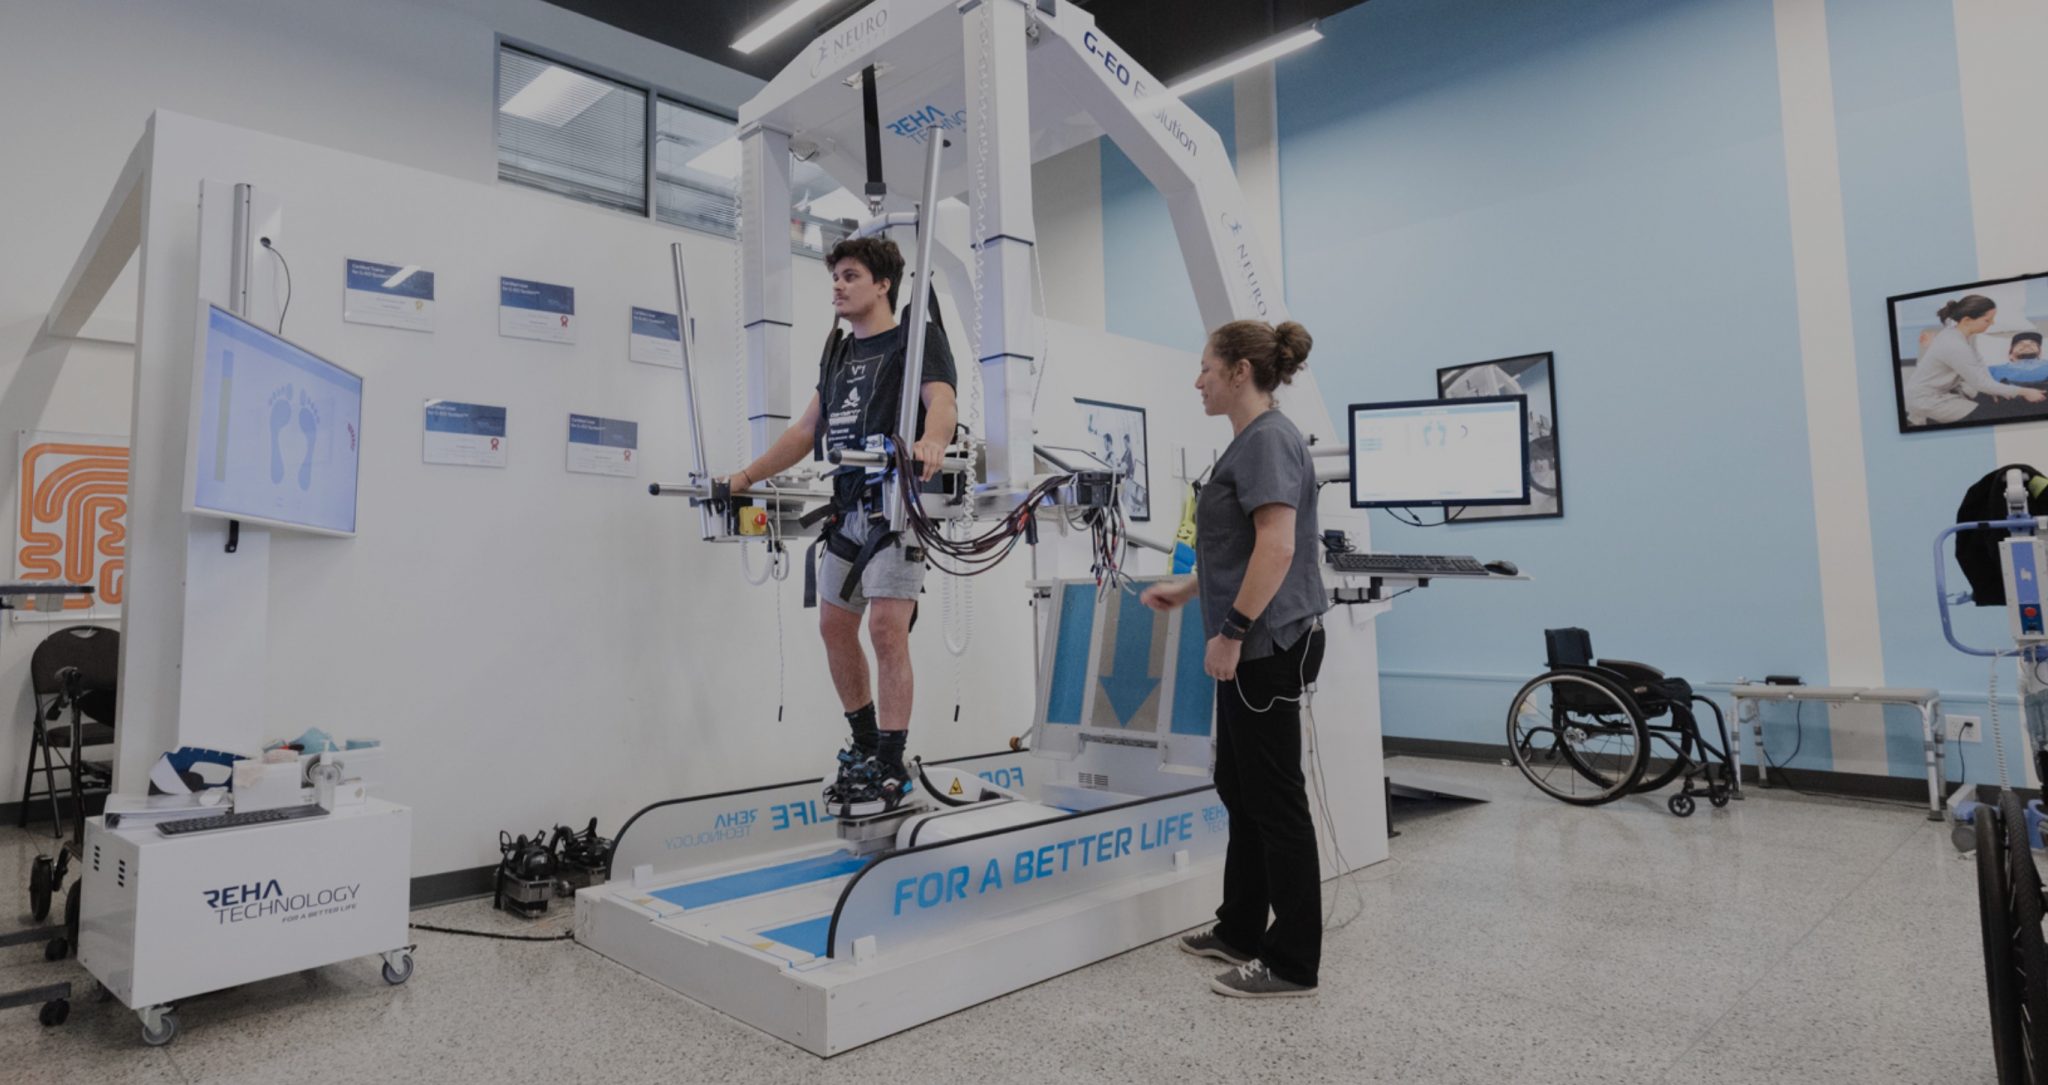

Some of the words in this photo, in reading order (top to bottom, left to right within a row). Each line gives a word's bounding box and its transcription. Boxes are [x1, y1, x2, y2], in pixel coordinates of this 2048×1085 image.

[833, 9, 888, 56] NEURO
[1083, 30, 1131, 86] G-EO
[885, 105, 945, 136] REHA
[1237, 243, 1267, 316] NEURO
[893, 865, 970, 916] FOR
[979, 857, 1002, 894] A
[1013, 826, 1133, 884] BETTER
[1140, 812, 1193, 851] LIFE
[202, 878, 283, 909] REHA
[214, 883, 361, 925] TECHNOLOGY
[281, 914, 299, 924] FOR
[307, 907, 339, 918] BETTER
[340, 903, 357, 913] LIFE
